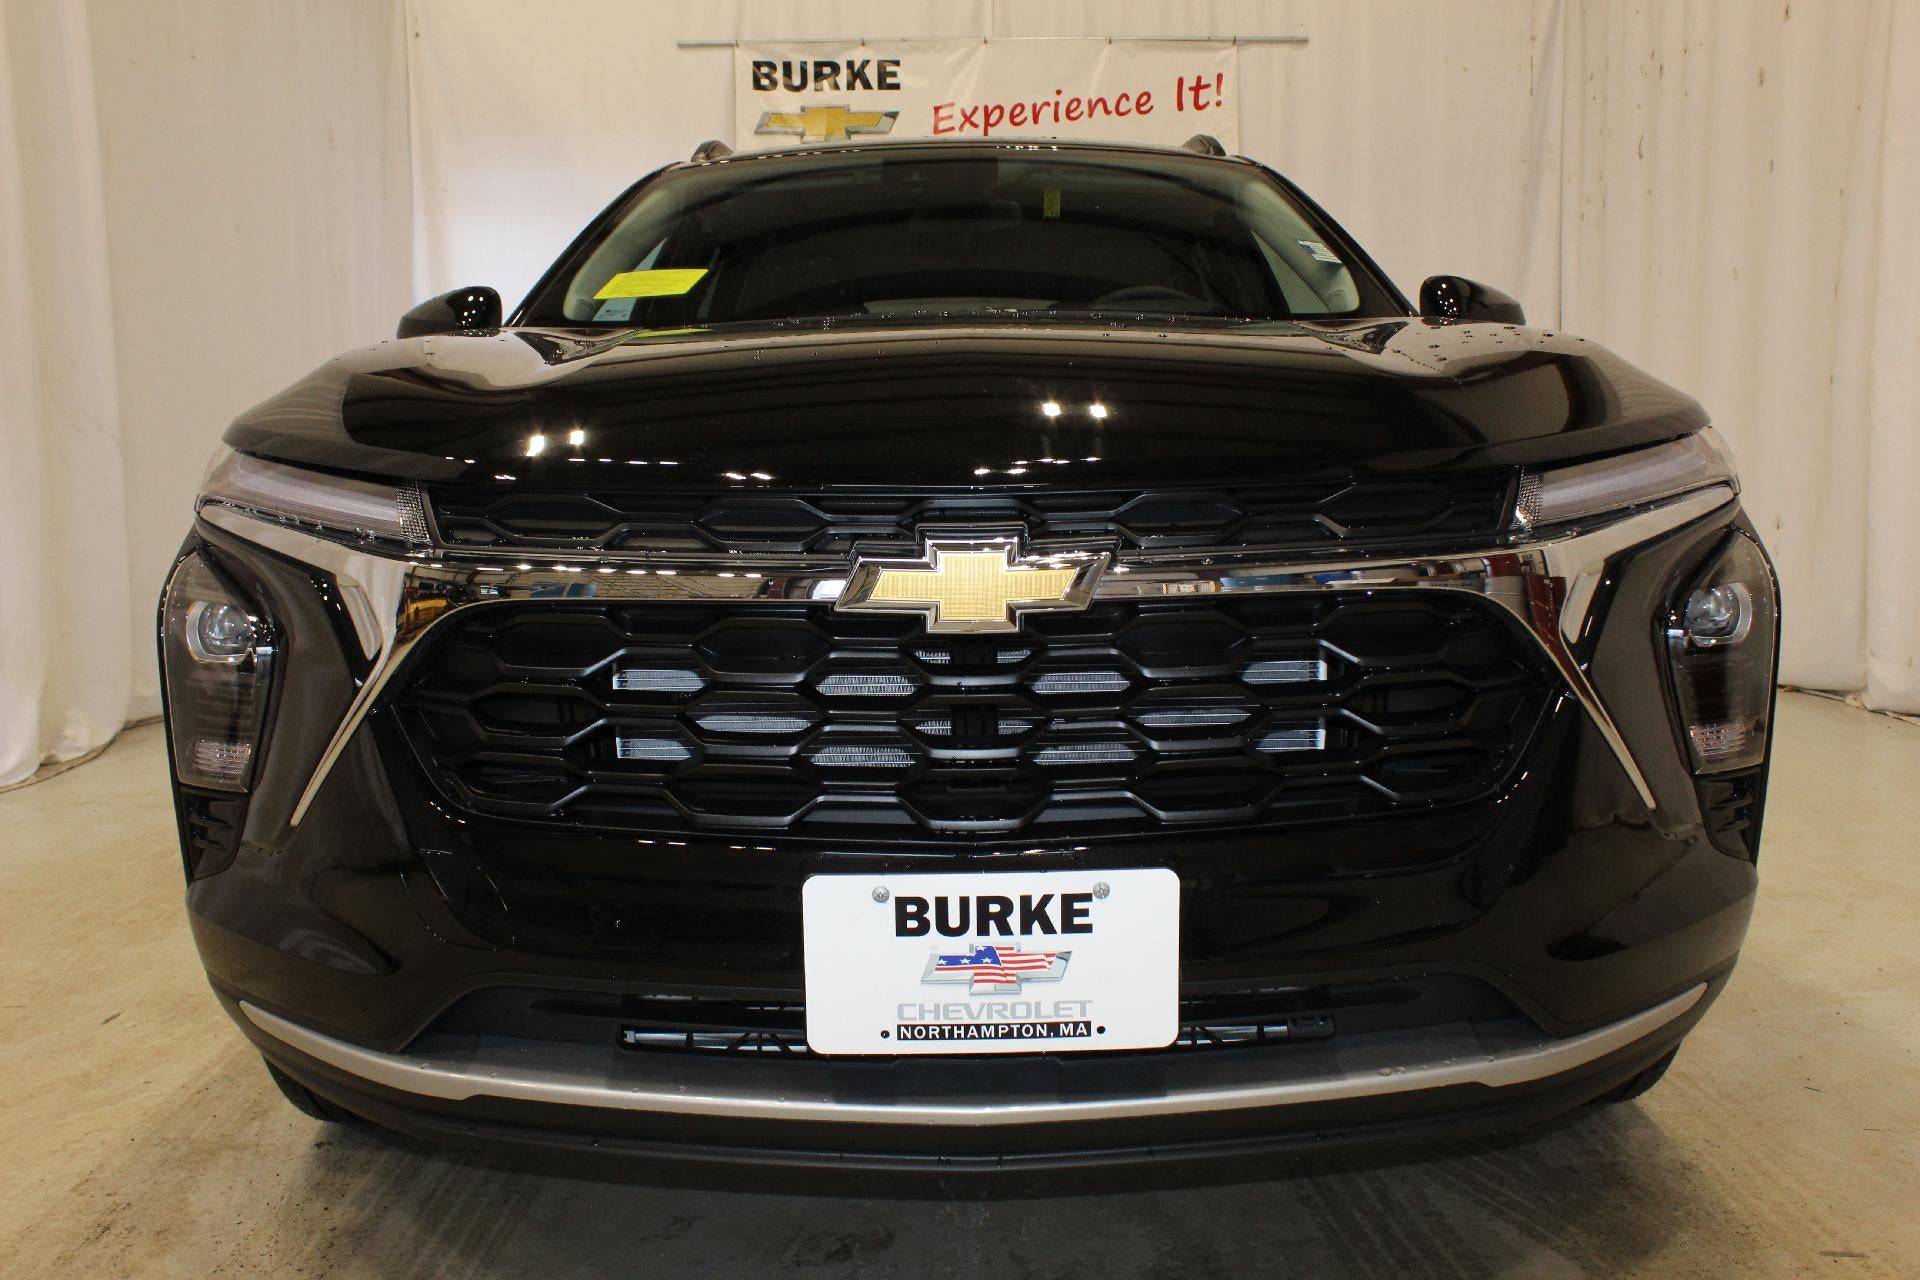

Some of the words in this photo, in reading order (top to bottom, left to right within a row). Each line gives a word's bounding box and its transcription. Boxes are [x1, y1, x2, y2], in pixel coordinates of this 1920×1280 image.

[752, 60, 901, 92] BURKE
[932, 89, 1154, 136] Experience
[1176, 72, 1224, 112] It!
[894, 892, 1093, 937] BURKE
[897, 1000, 1093, 1021] CHEVROLET
[900, 1024, 1055, 1039] NORTHAMPTON,
[1060, 1023, 1088, 1036] MA
